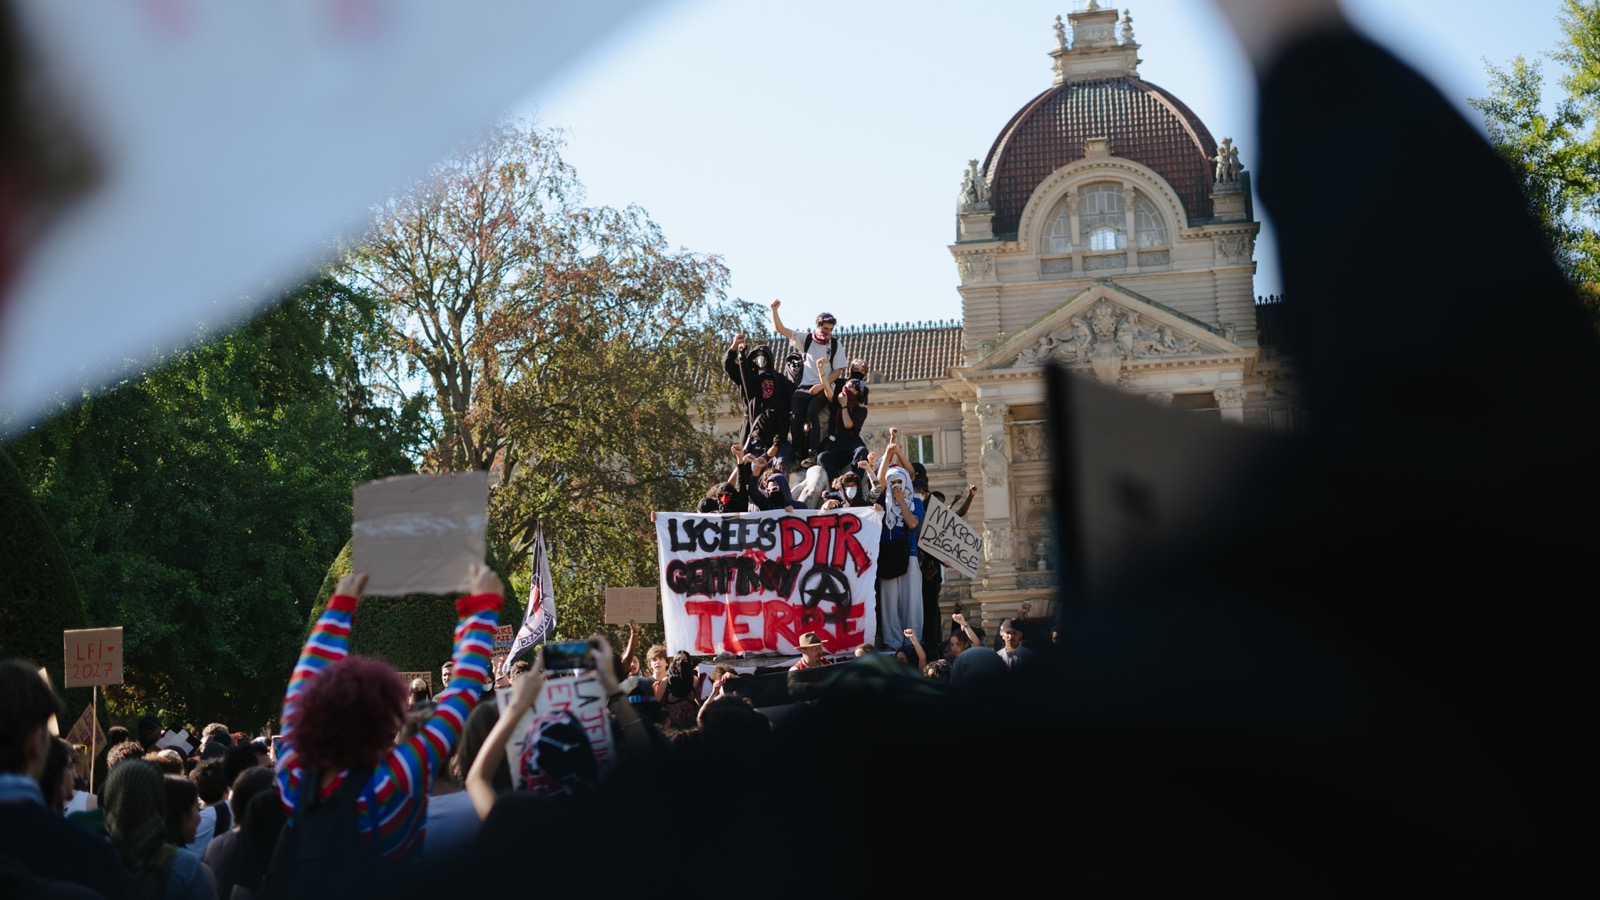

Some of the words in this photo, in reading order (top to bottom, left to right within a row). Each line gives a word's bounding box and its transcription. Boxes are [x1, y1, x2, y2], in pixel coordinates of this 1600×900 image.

[778, 513, 873, 577] DTR
[929, 505, 983, 552] MACRON
[685, 600, 866, 654] TERRE
[72, 662, 113, 680] 2027
[574, 678, 601, 708] LA
